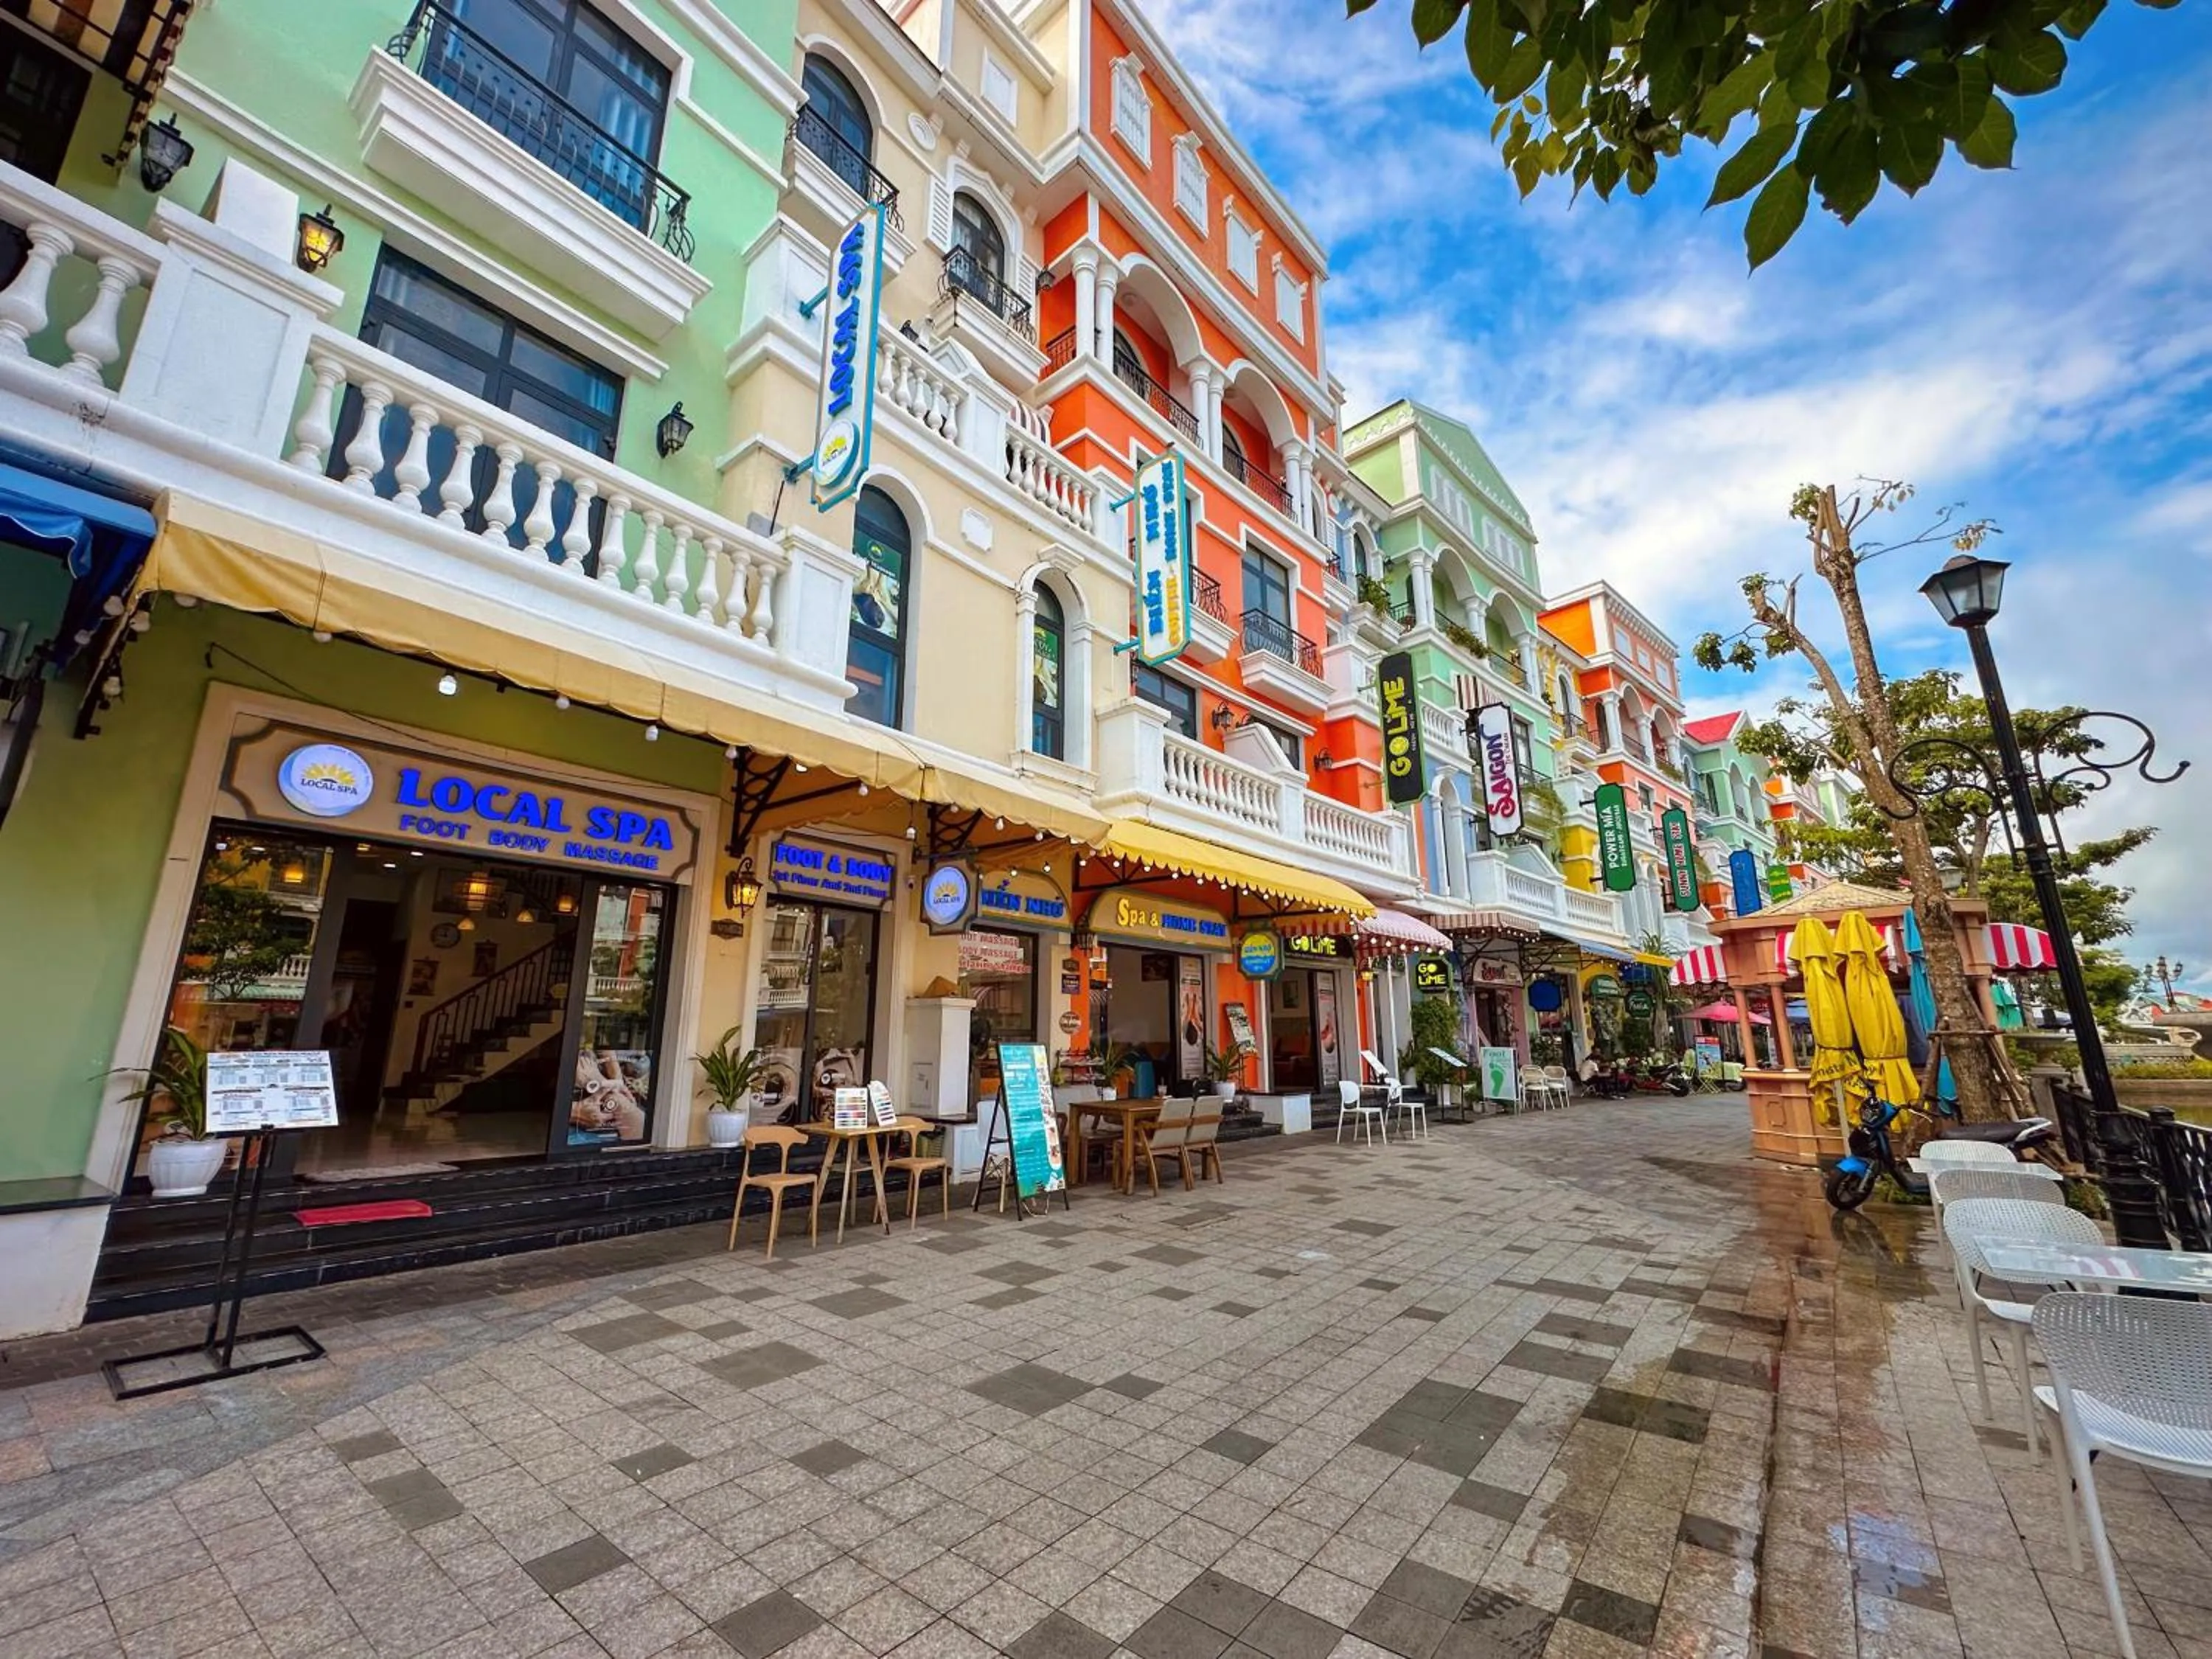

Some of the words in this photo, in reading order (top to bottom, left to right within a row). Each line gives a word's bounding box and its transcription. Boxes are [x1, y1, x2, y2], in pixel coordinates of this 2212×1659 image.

[837, 222, 865, 299] SPA
[828, 296, 860, 417] LOCAL
[1389, 736, 1412, 776] GO
[1479, 723, 1516, 818] SAIGON
[301, 778, 336, 791] LOCAL
[337, 785, 358, 796] SPA
[395, 768, 571, 832] LOCAL
[586, 806, 674, 851] SPA
[399, 814, 471, 840] FOOT
[487, 830, 552, 853] BODY
[564, 842, 660, 871] MASSAGE
[1604, 830, 1619, 869] POWER
[775, 843, 824, 869] FOOT
[827, 854, 842, 874] &
[846, 858, 894, 883] BODY
[1117, 897, 1146, 927] Spa
[1150, 911, 1158, 927] &
[1161, 913, 1197, 933] HOME
[1418, 963, 1437, 973] GO
